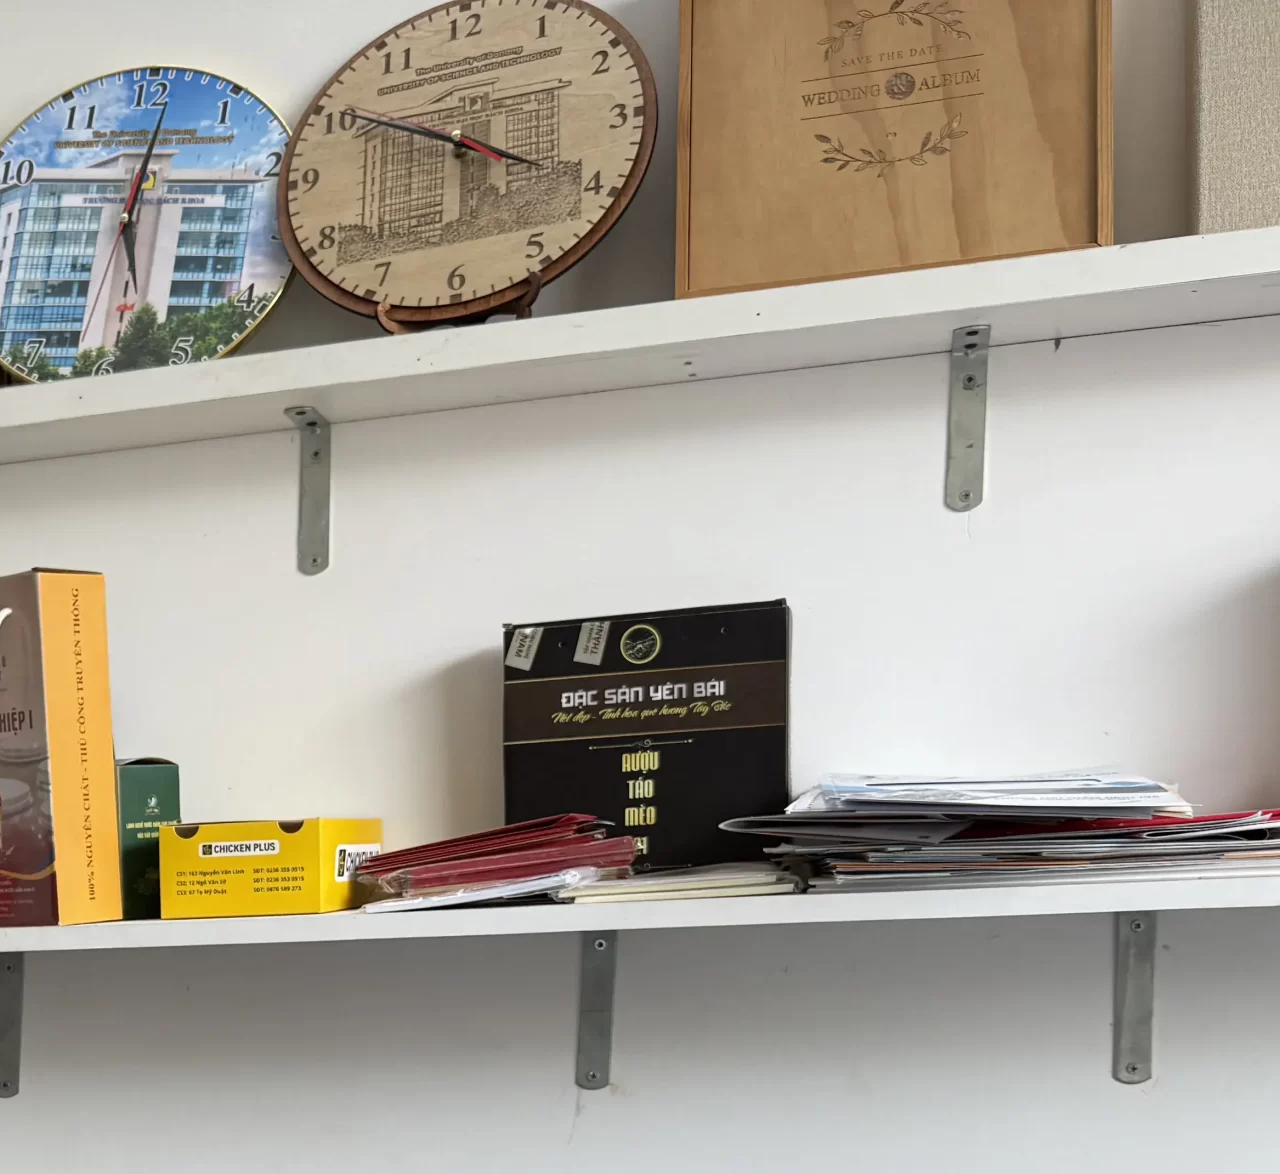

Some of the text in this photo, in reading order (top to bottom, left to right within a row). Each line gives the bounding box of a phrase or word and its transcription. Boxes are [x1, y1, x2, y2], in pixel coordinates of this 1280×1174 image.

[448, 13, 483, 42] 12
[591, 50, 610, 75] 2
[841, 44, 944, 68] SAVE THE DATE
[377, 46, 563, 96] UNIVERSITY OF SCIENCE AND TECHNOLOGY
[130, 81, 170, 110] 12
[801, 69, 981, 107] WEDDING ALBUM
[62, 103, 98, 131] 11
[609, 104, 628, 129] 3
[302, 167, 320, 194] 9
[525, 232, 545, 259] 5
[447, 264, 466, 291] 6
[561, 678, 727, 709] ĐẶC SẢN YÊN BÁI
[0, 707, 26, 736] HIỆP
[622, 750, 660, 774] RƯỢU
[626, 777, 655, 799] TÁO
[624, 804, 657, 827] MÈO
[214, 842, 276, 854] CHICKEN PLUS
